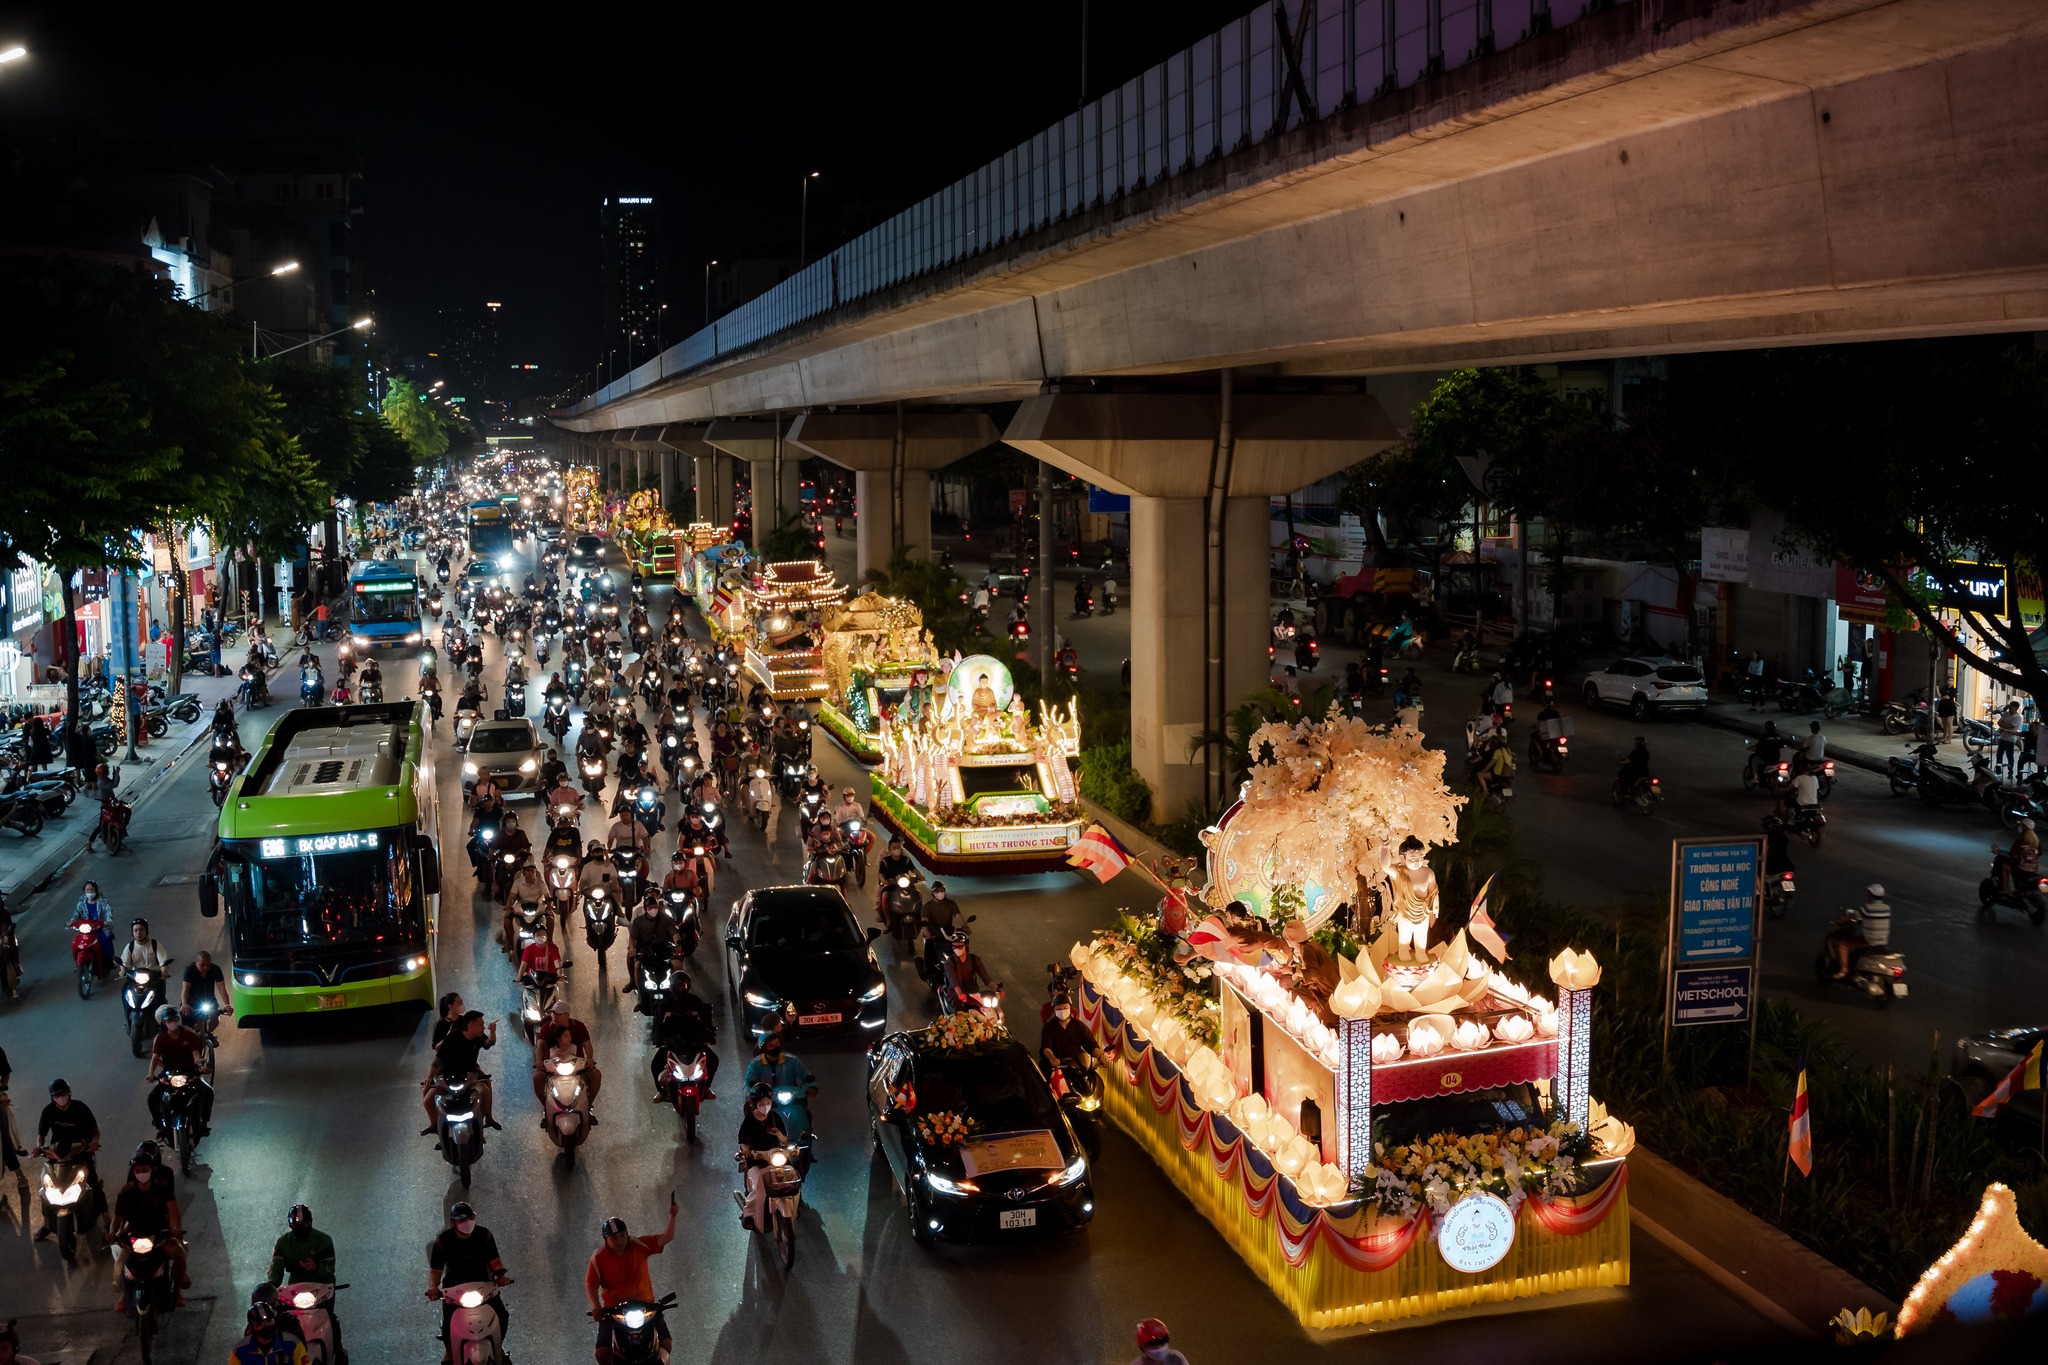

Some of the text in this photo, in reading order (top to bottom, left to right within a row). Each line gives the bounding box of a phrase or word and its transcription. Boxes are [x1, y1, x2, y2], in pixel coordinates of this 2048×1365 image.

[1684, 899, 1700, 912] GIAO
[1684, 927, 1715, 935] TRANSPORT
[1701, 939, 1715, 948] 300
[1677, 987, 1747, 1001] VIETSCHOOL
[1446, 1075, 1457, 1085] 04
[1010, 1210, 1026, 1219] 30H
